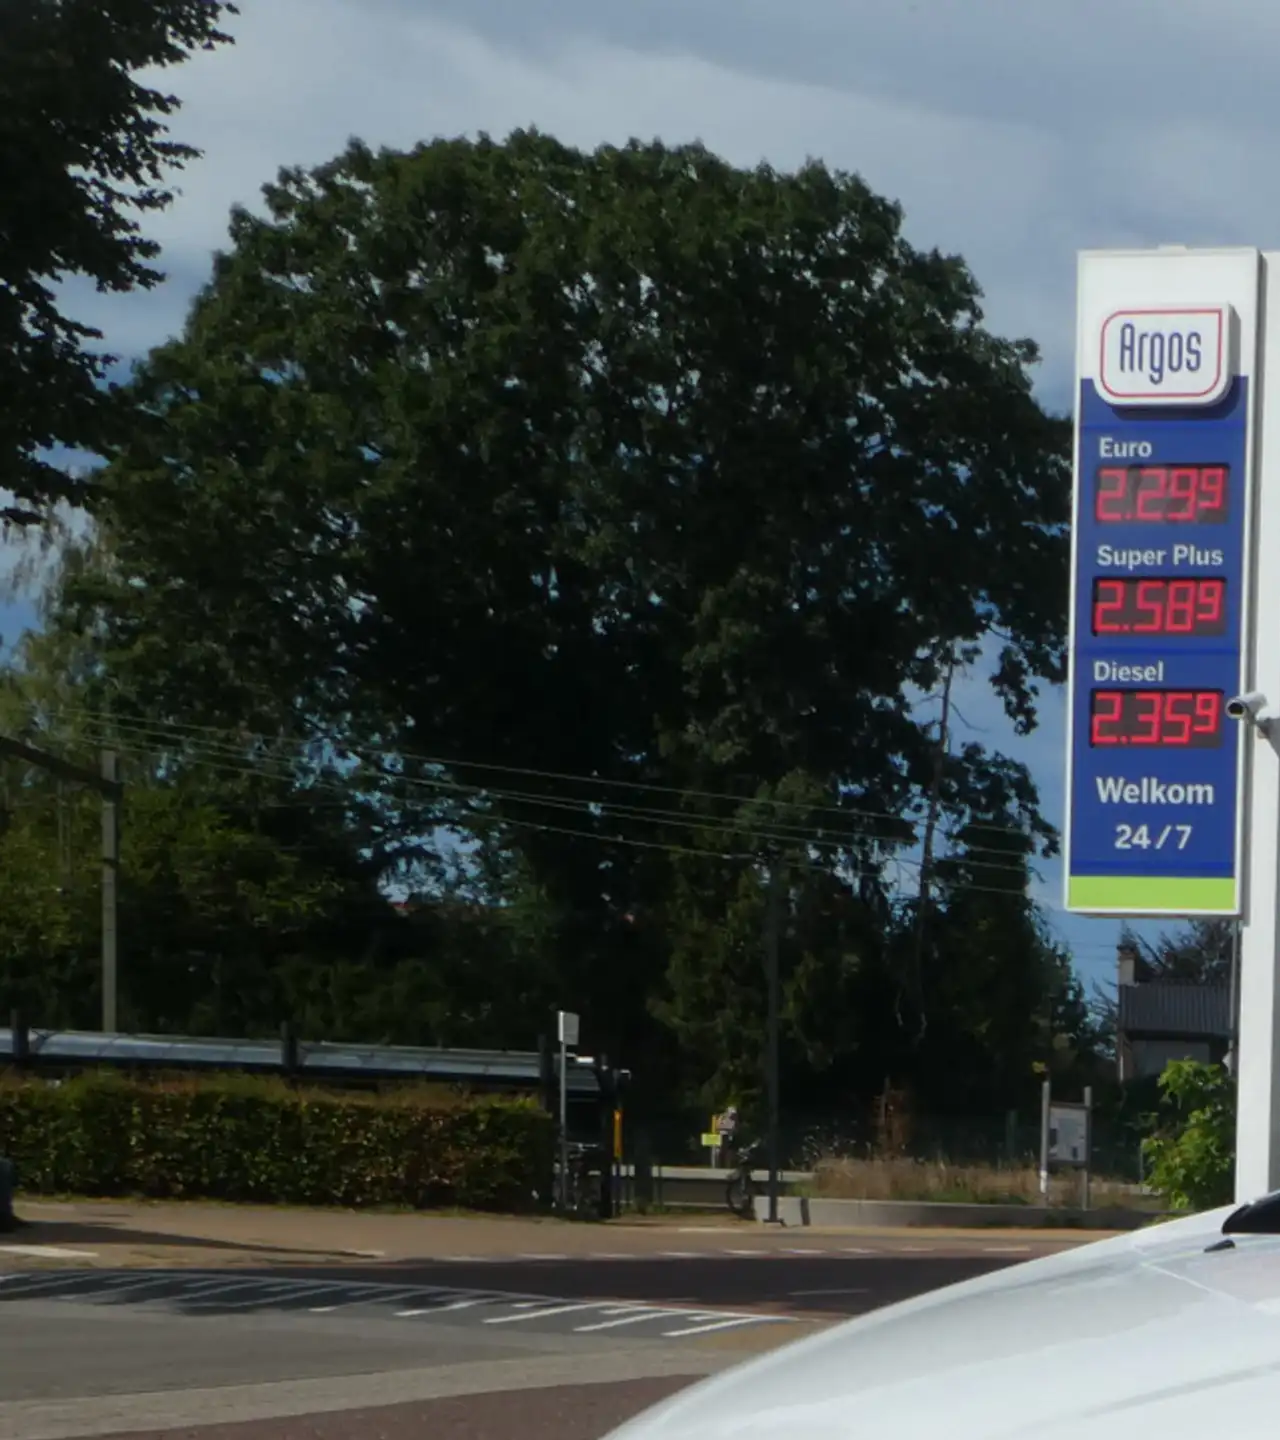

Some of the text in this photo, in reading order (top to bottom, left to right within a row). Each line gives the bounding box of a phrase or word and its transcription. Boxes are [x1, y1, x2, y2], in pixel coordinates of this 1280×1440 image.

[1119, 322, 1202, 386] Argos
[1099, 437, 1153, 458] Euro
[1096, 467, 1227, 522] 2.299
[1096, 545, 1224, 570] Super Plus
[1093, 579, 1224, 632] 2.589
[1093, 661, 1165, 682] Diesel
[1091, 691, 1220, 744] 2.359
[1095, 777, 1215, 805] Welkom
